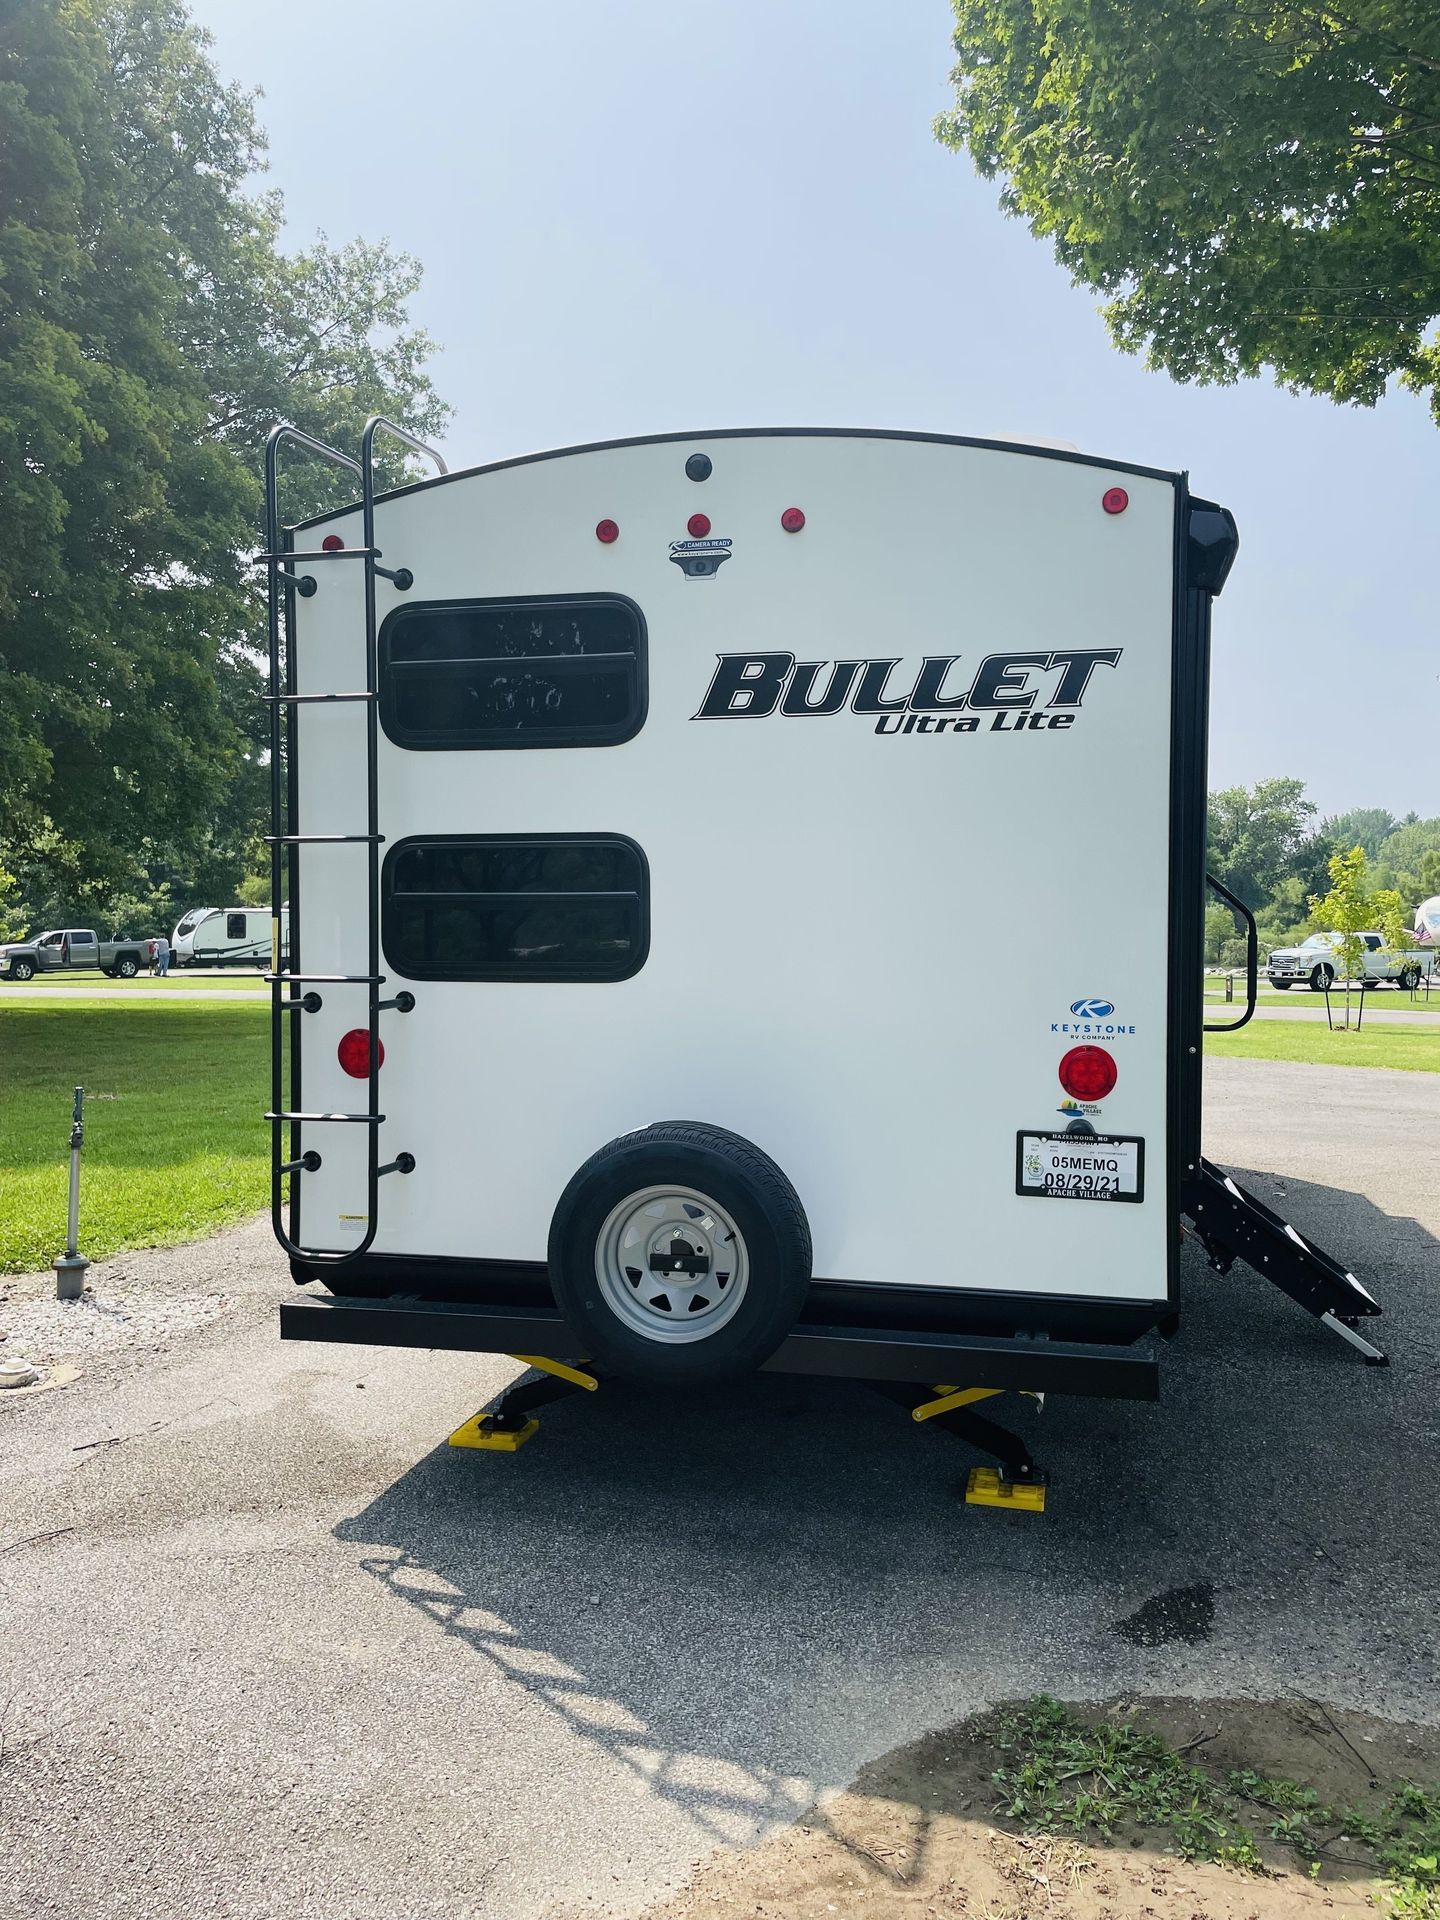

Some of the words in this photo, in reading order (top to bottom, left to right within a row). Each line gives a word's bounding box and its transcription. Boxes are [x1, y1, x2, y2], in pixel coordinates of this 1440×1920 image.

[874, 713, 981, 735] Ultra
[990, 709, 1077, 732] Lite
[1051, 1023, 1136, 1034] KEYSTONE
[1052, 1156, 1118, 1173] 05MEMQ
[1044, 1173, 1120, 1193] 08/29/21
[1047, 1189, 1077, 1197] APACHE
[1079, 1191, 1112, 1199] VILLAGE
